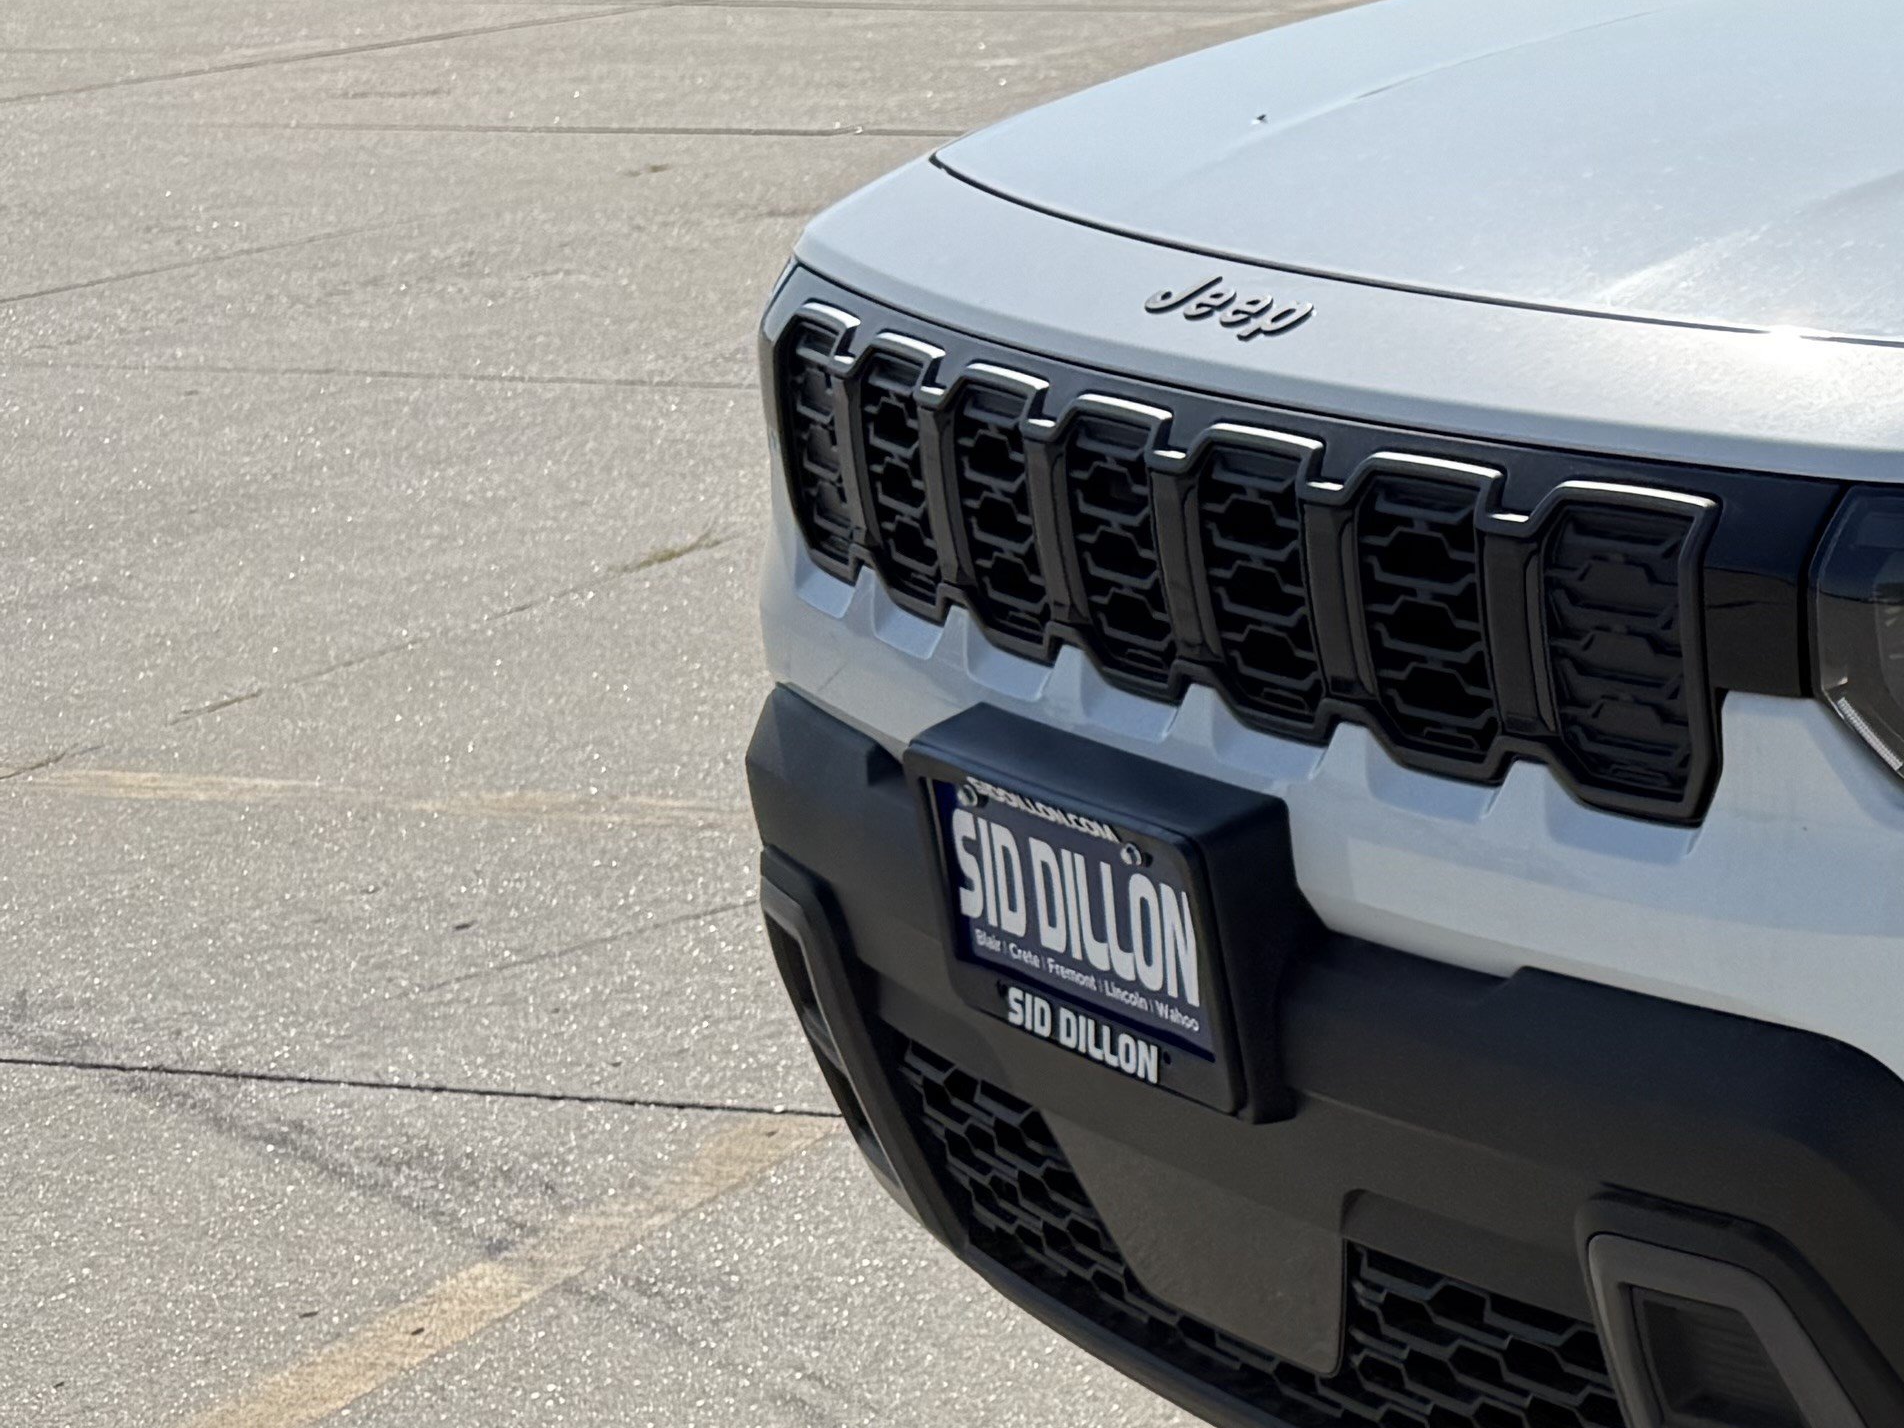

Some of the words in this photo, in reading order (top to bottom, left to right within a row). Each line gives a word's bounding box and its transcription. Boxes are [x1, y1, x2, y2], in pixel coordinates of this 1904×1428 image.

[1144, 276, 1315, 341] Jeep
[952, 808, 1027, 938] SID
[1028, 836, 1200, 1008] DILLON
[974, 928, 1001, 953] Blair
[1008, 942, 1041, 969] Crete
[1046, 957, 1098, 992] Fremont
[1103, 979, 1149, 1012] Lincoln
[1155, 999, 1200, 1032] Wahoo
[1007, 986, 1052, 1038] SID
[1058, 1006, 1159, 1085] DILLON
